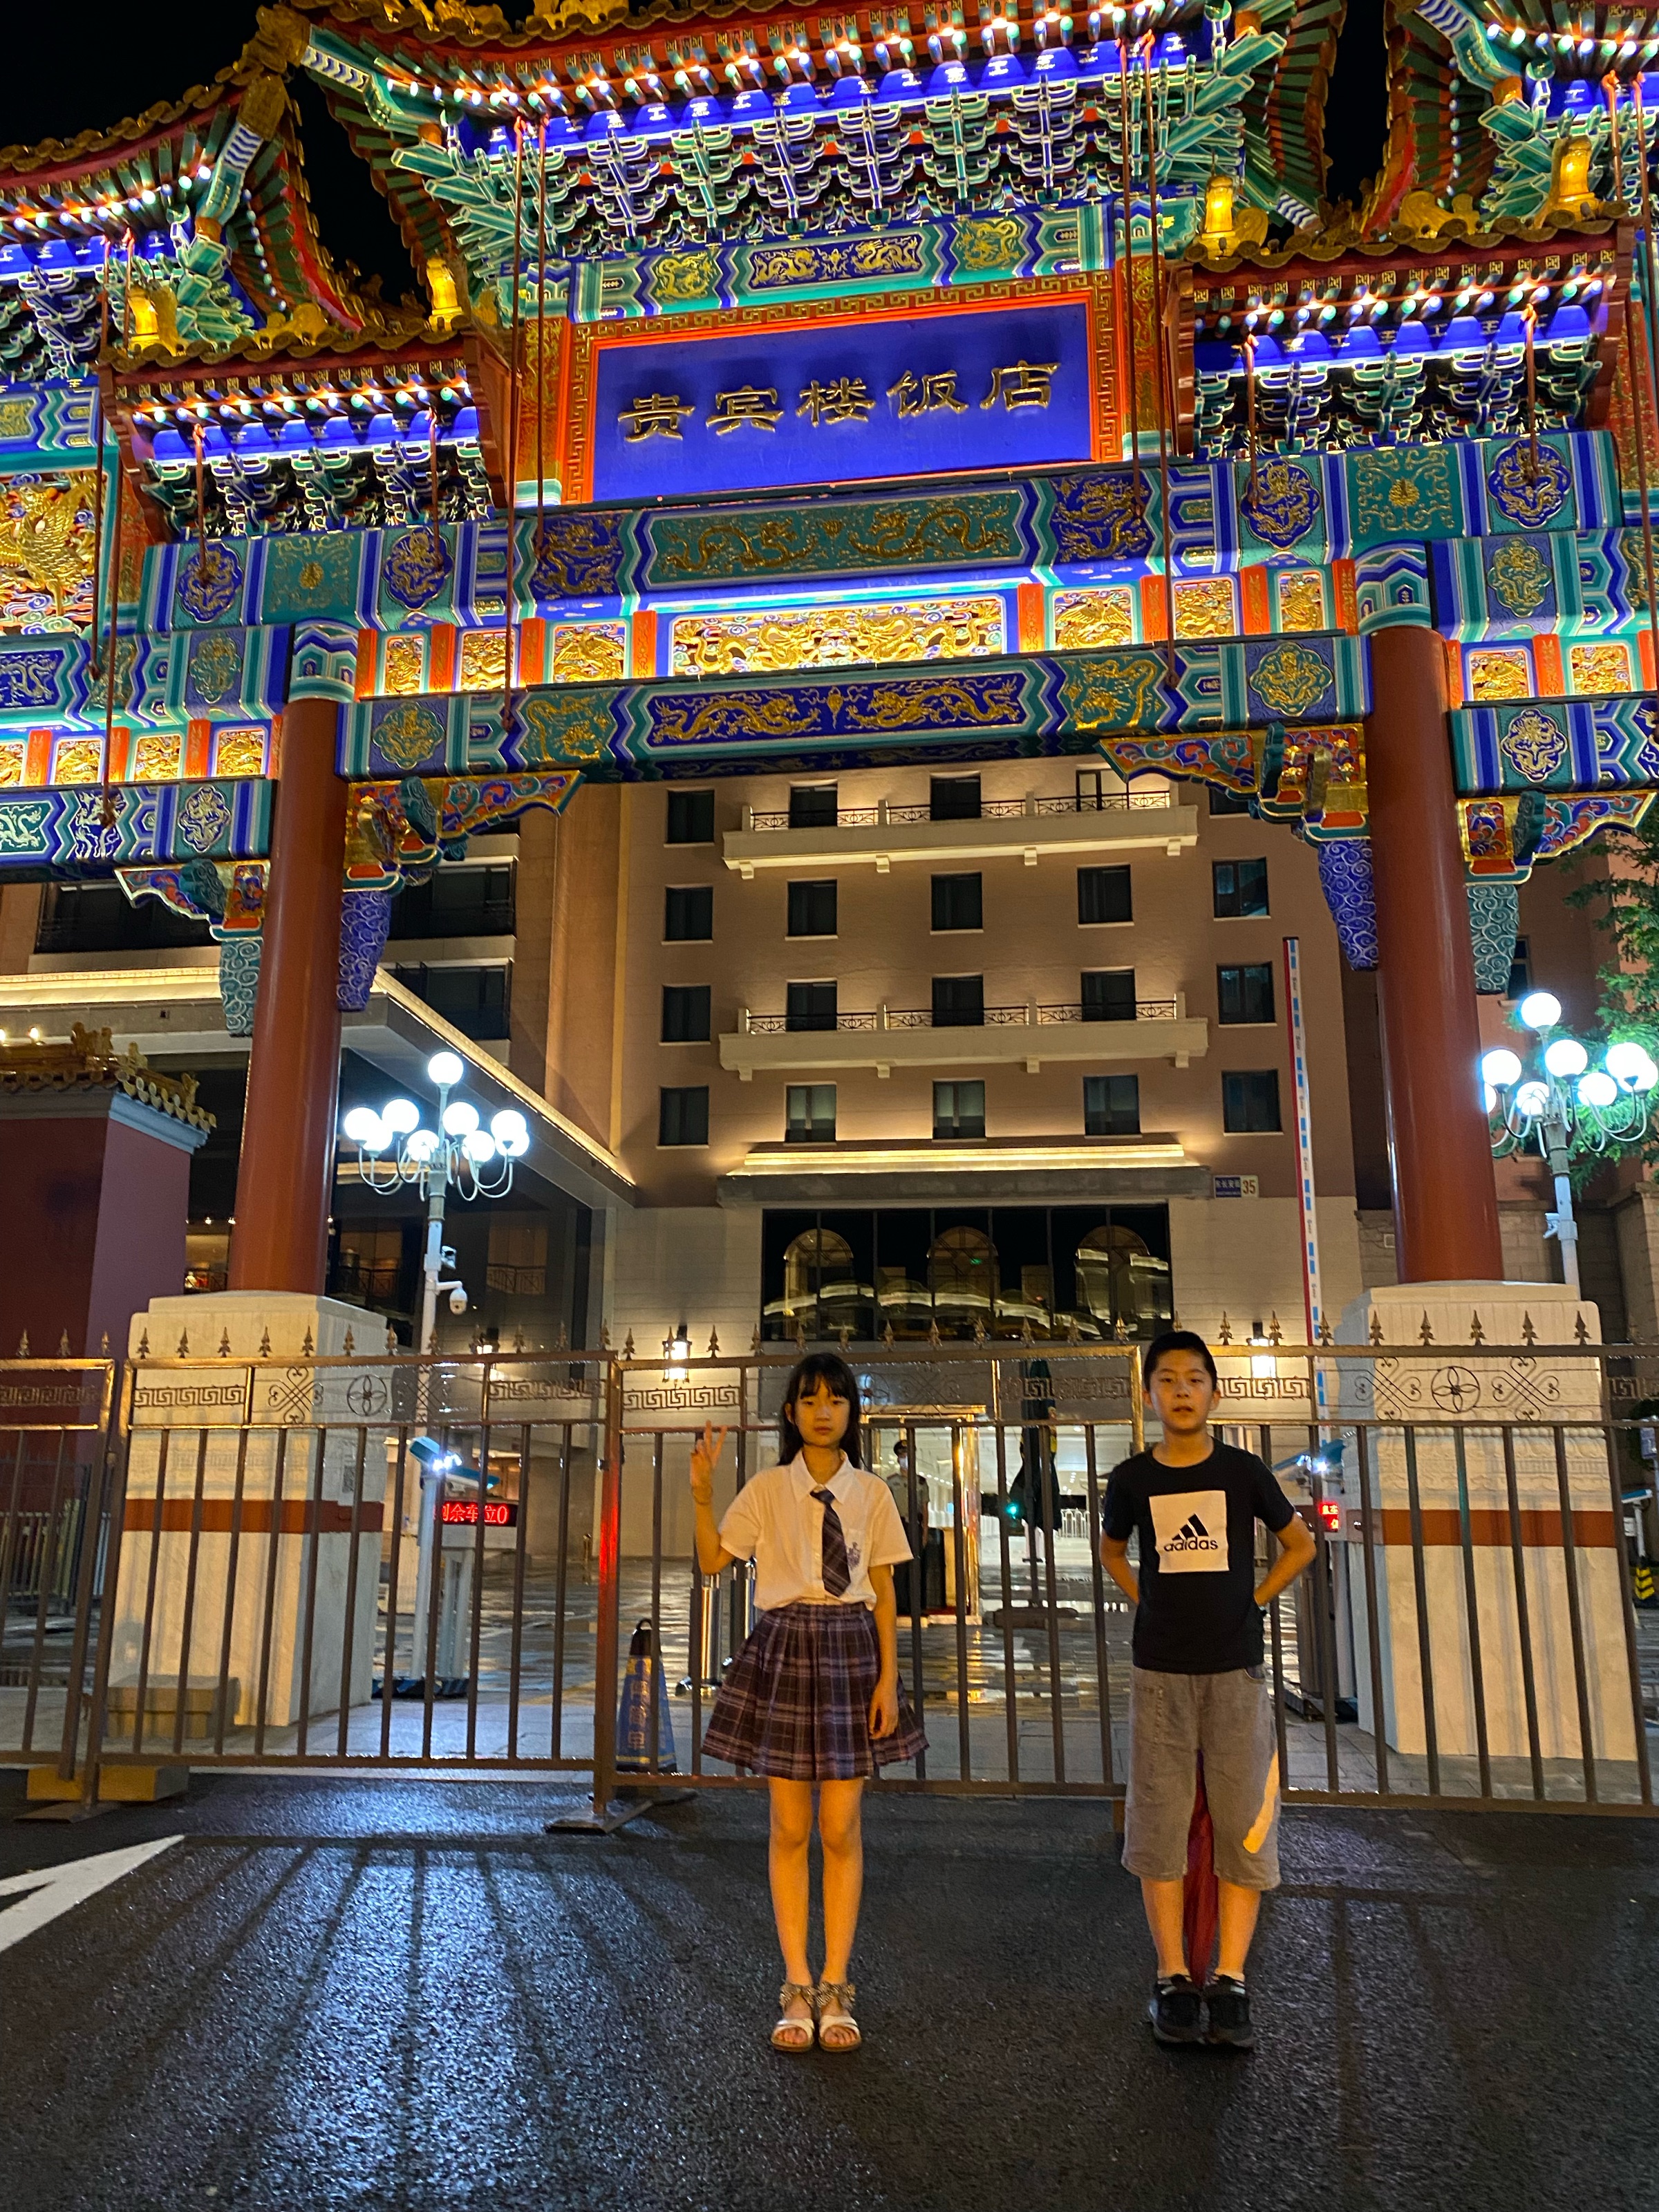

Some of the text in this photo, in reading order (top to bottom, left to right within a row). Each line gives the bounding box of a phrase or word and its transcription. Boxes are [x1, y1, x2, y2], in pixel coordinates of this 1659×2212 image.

[618, 360, 1061, 442] 贵宾楼饭店
[1242, 1179, 1256, 1194] 35
[1163, 1536, 1219, 1552] adidas
